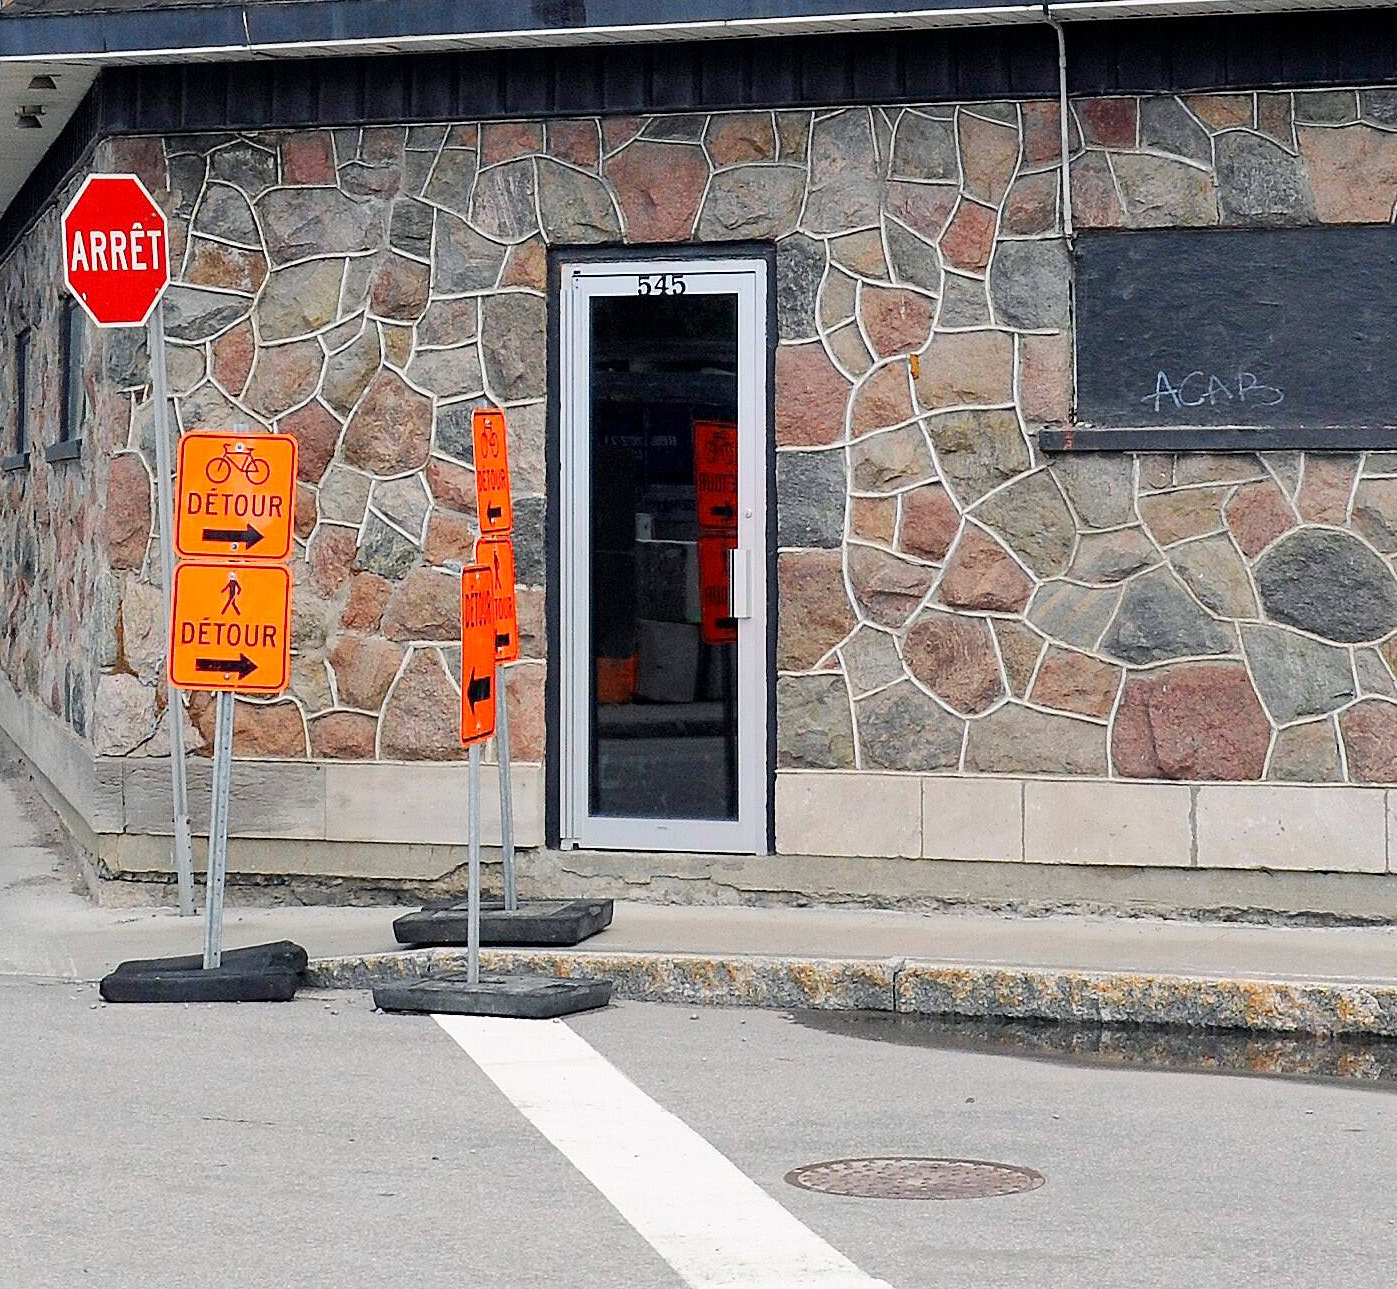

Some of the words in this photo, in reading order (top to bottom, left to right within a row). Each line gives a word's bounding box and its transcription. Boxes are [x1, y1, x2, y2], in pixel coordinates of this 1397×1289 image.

[71, 222, 162, 271] ARRÊT
[637, 274, 686, 296] 545
[1140, 370, 1285, 411] ACAB
[187, 487, 283, 518] DÉTOUR
[181, 617, 277, 649] DÉTOUR
